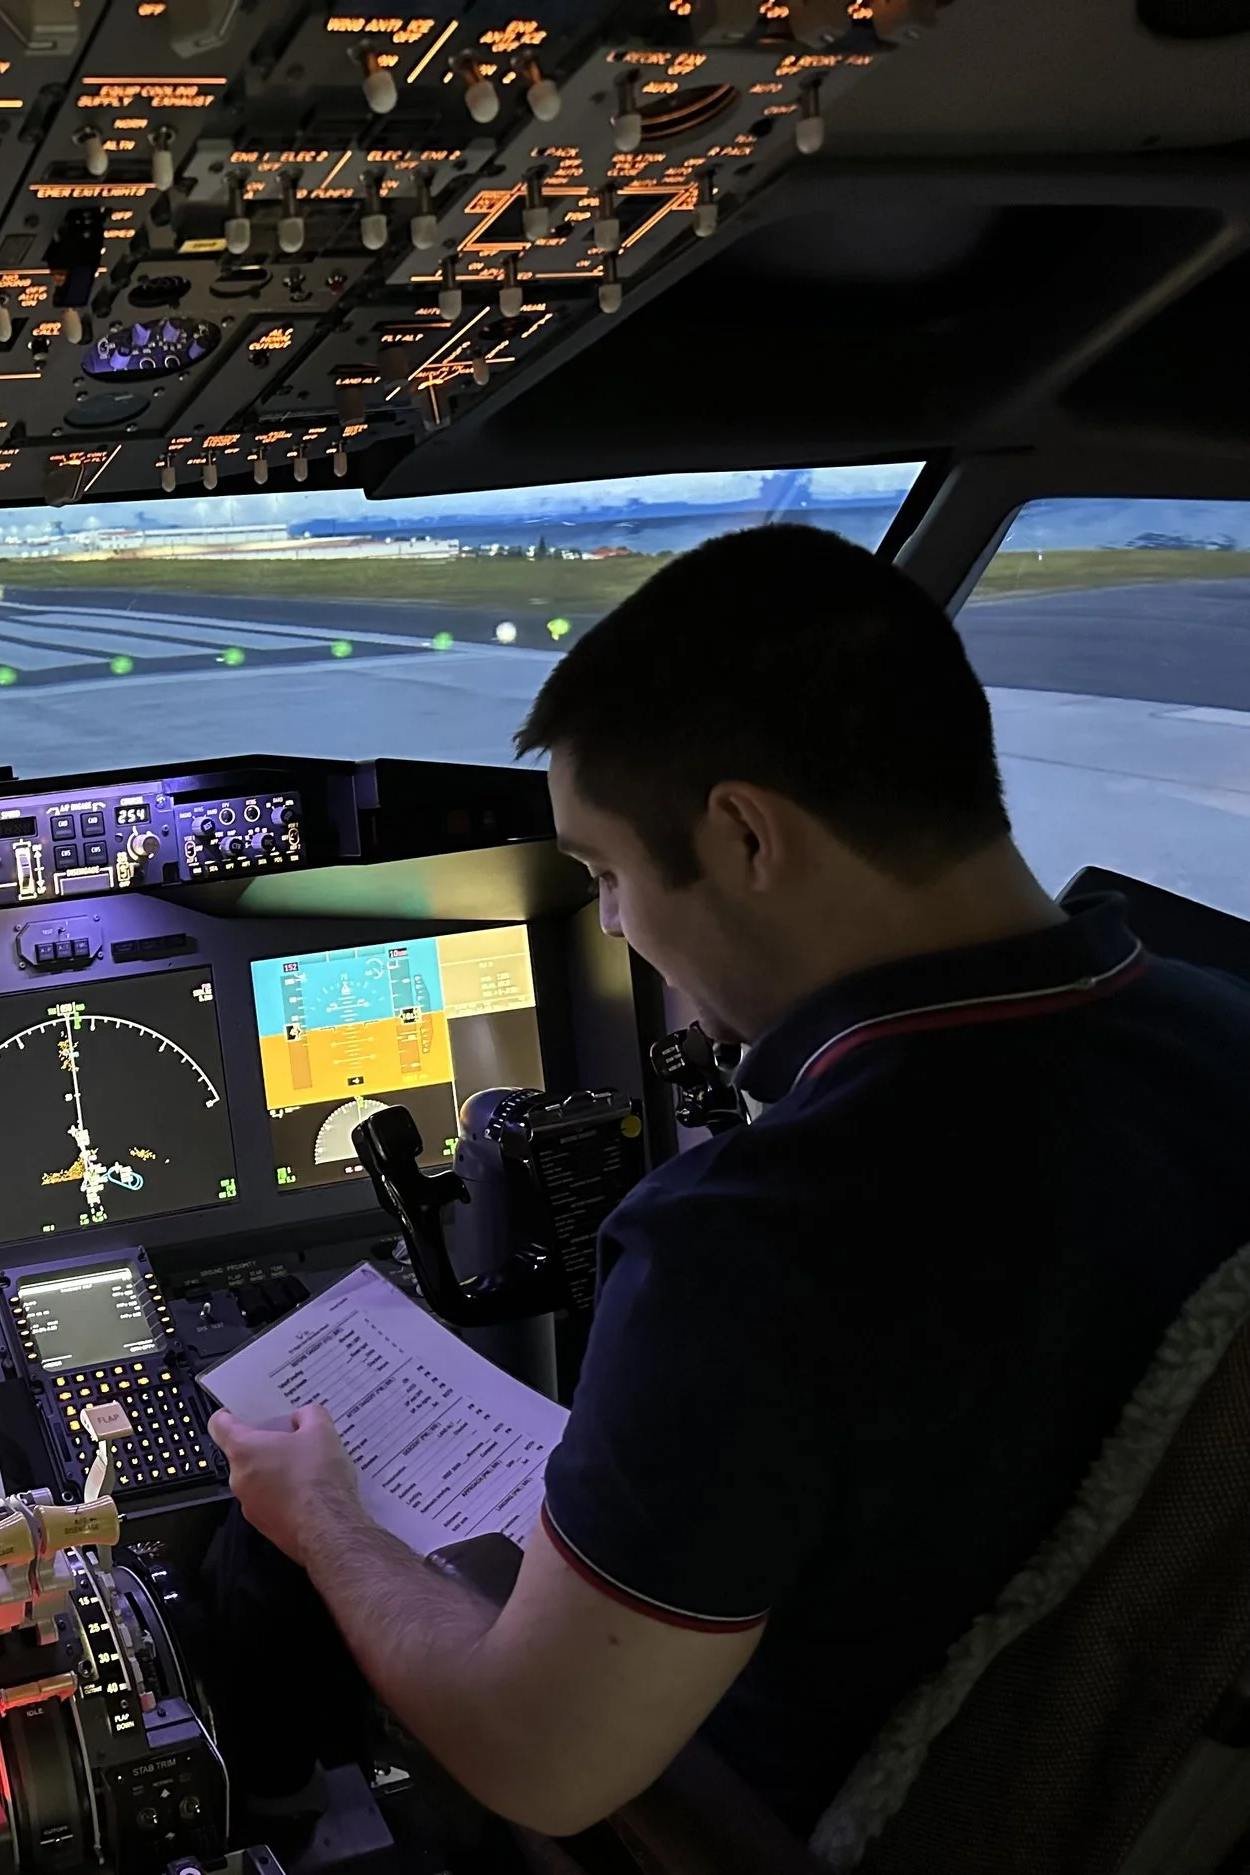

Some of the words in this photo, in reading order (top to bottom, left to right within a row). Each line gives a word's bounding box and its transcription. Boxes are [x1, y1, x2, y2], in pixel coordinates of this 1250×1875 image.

[280, 151, 316, 162] ELEC
[32, 328, 60, 336] CALL
[117, 808, 145, 824] 254
[284, 963, 297, 971] 152
[97, 1414, 119, 1424] FLAP
[78, 1597, 90, 1606] 15
[88, 1623, 100, 1633] 25
[98, 1653, 110, 1663] 30
[106, 1682, 118, 1693] 40
[26, 1707, 44, 1717] IDLE
[114, 1713, 130, 1722] FLAP
[116, 1720, 135, 1731] DOWN
[132, 1766, 155, 1777] STAB
[155, 1758, 177, 1771] TRIM
